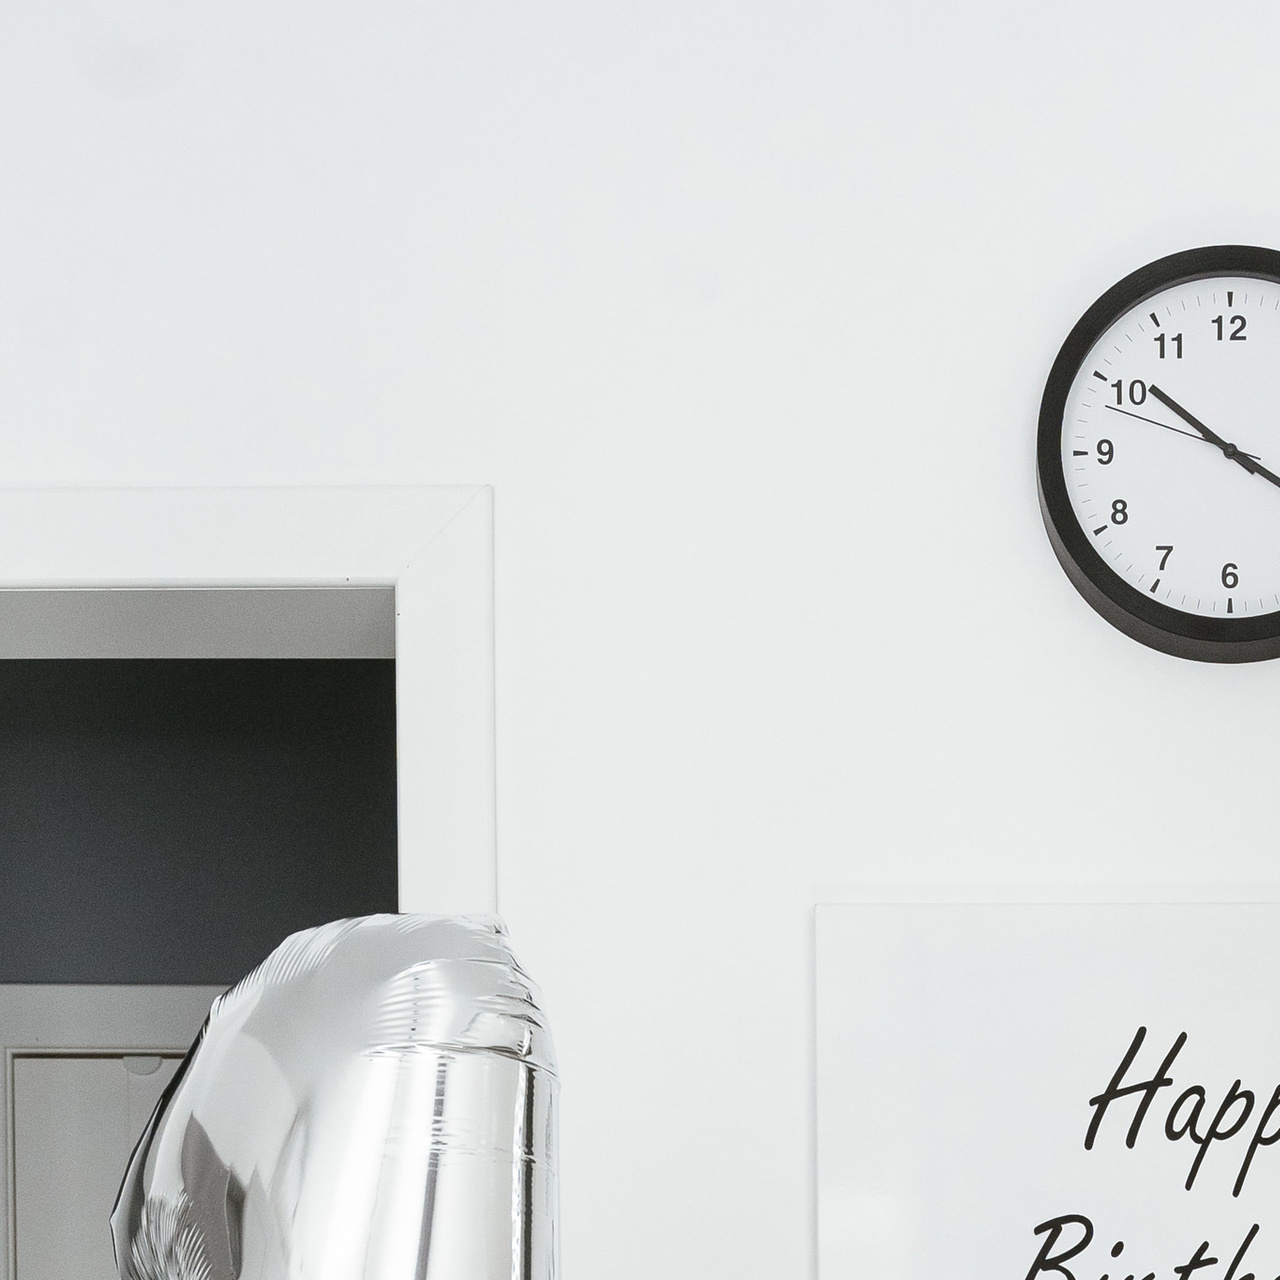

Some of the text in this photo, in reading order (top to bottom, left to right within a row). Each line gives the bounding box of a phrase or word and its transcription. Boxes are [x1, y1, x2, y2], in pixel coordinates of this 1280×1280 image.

[1211, 314, 1247, 341] 12
[1153, 333, 1183, 359] 11
[1110, 379, 1147, 406] 10
[1096, 438, 1114, 466] 9
[1110, 499, 1129, 525] 8
[1155, 545, 1174, 571] 7
[1221, 562, 1239, 589] 6
